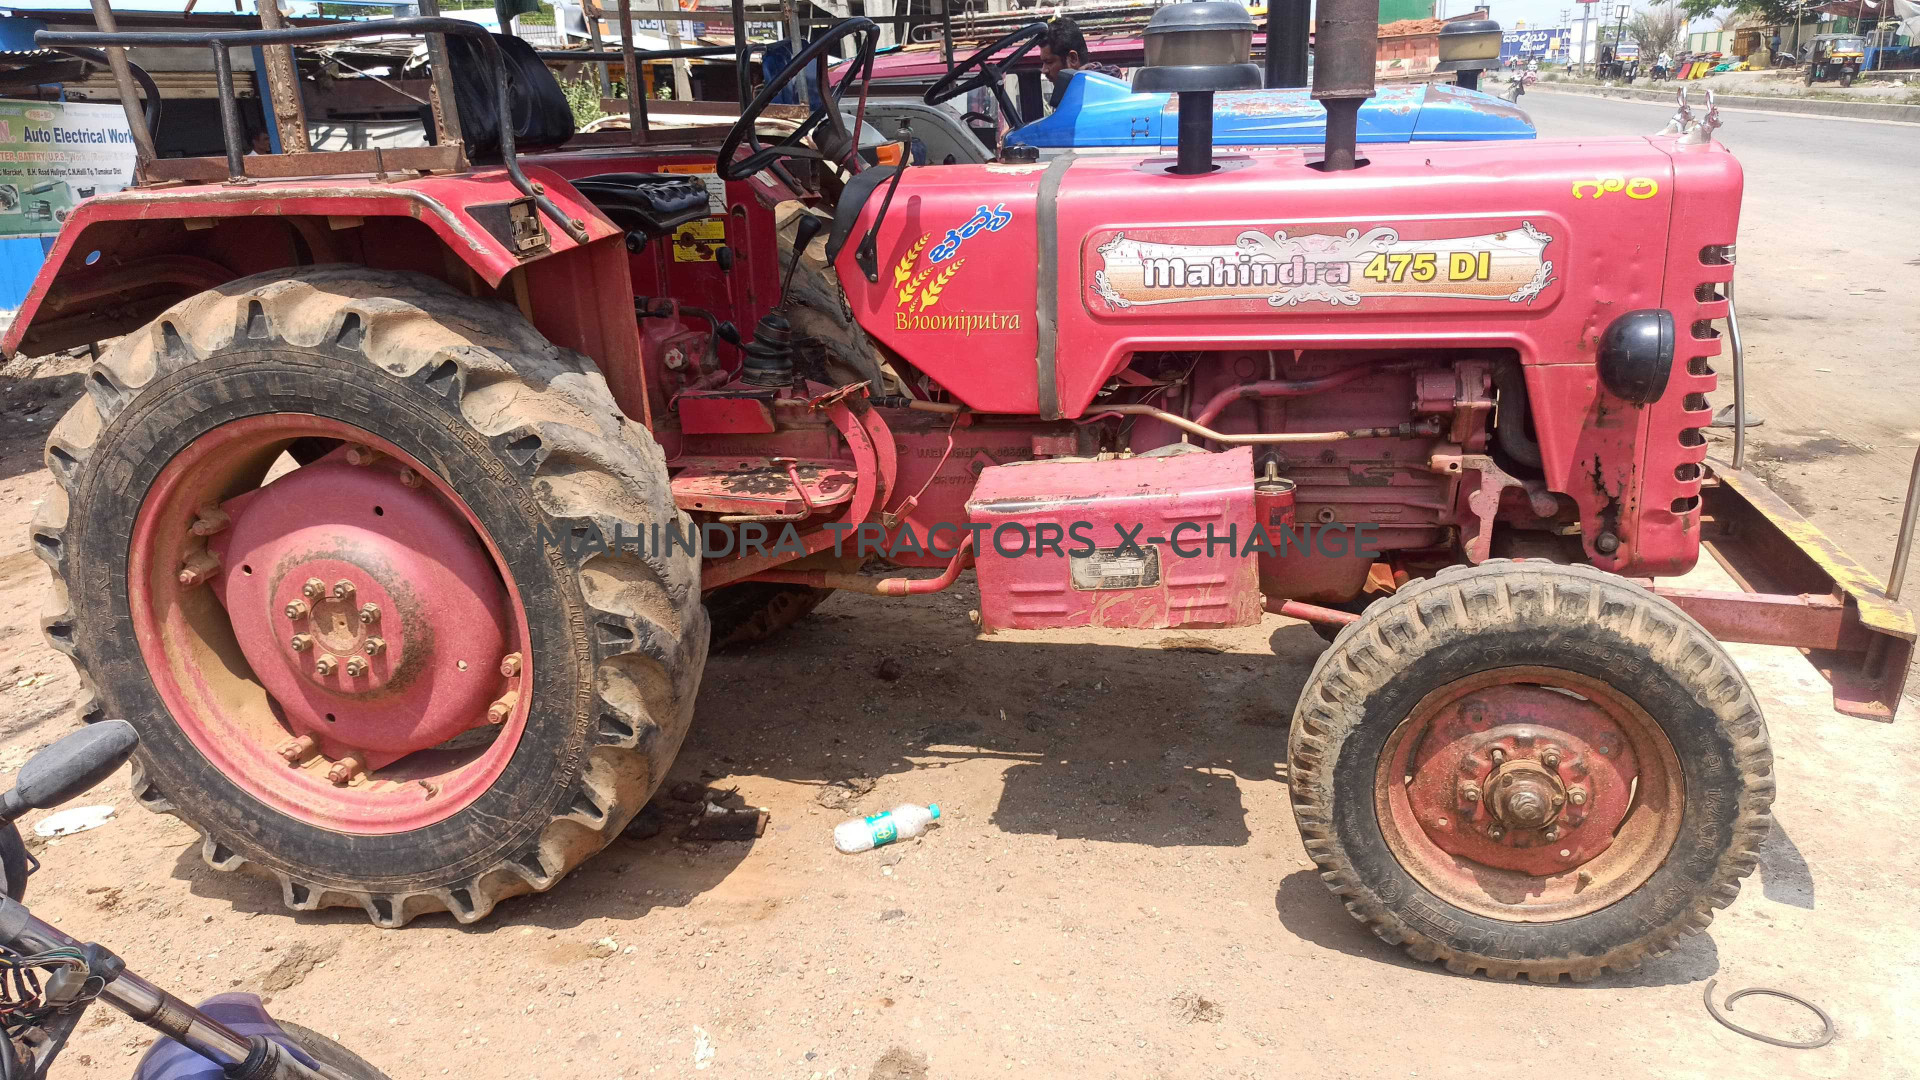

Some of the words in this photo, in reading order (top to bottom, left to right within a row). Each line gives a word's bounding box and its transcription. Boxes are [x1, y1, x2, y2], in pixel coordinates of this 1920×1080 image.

[24, 126, 51, 143] Auto
[53, 127, 107, 143] Electrical
[1142, 253, 1351, 288] Mahindra
[1363, 252, 1437, 283] 475
[1449, 251, 1490, 281] DI
[895, 309, 1020, 337] Bhoomiputra
